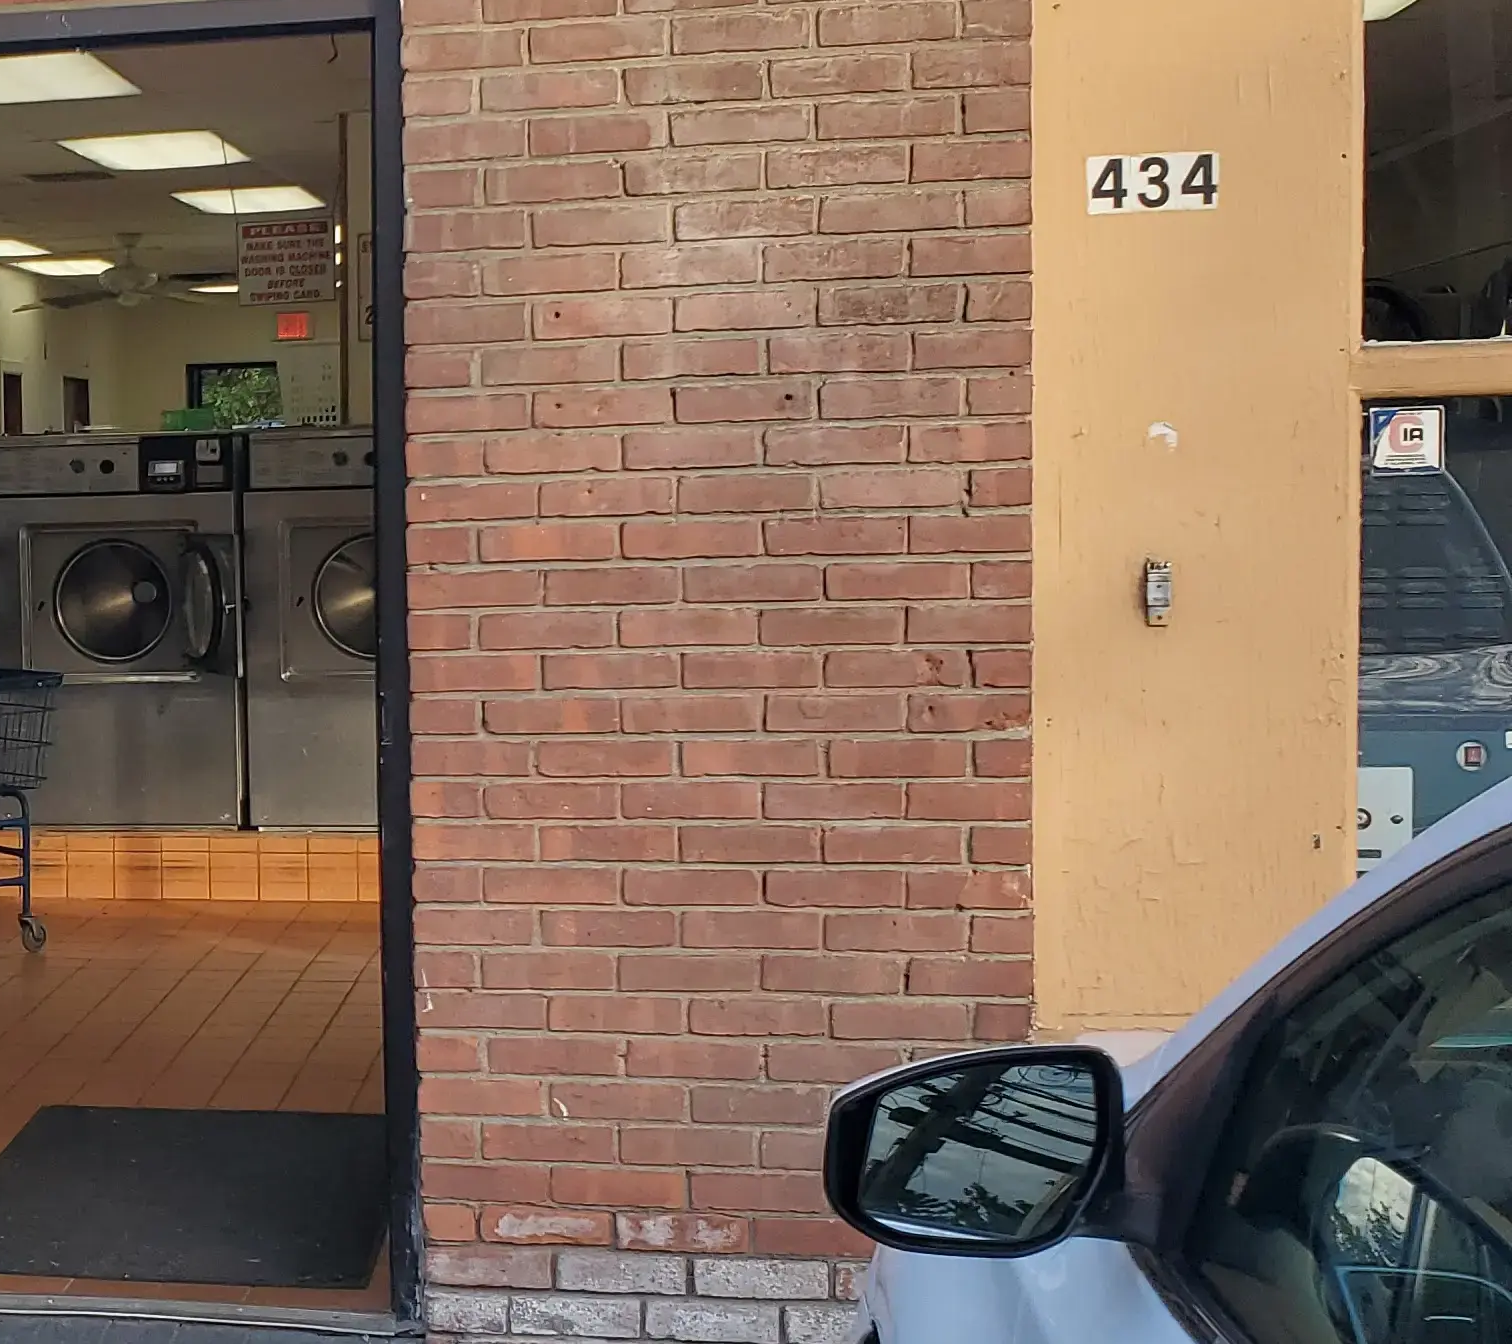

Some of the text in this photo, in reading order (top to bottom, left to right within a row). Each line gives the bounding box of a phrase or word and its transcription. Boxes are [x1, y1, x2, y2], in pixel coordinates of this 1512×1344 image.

[1092, 154, 1217, 209] 434
[289, 251, 332, 262] MACHINE
[245, 267, 272, 277] DOOR
[289, 264, 327, 276] CLOSED
[268, 278, 305, 289] BEFORE
